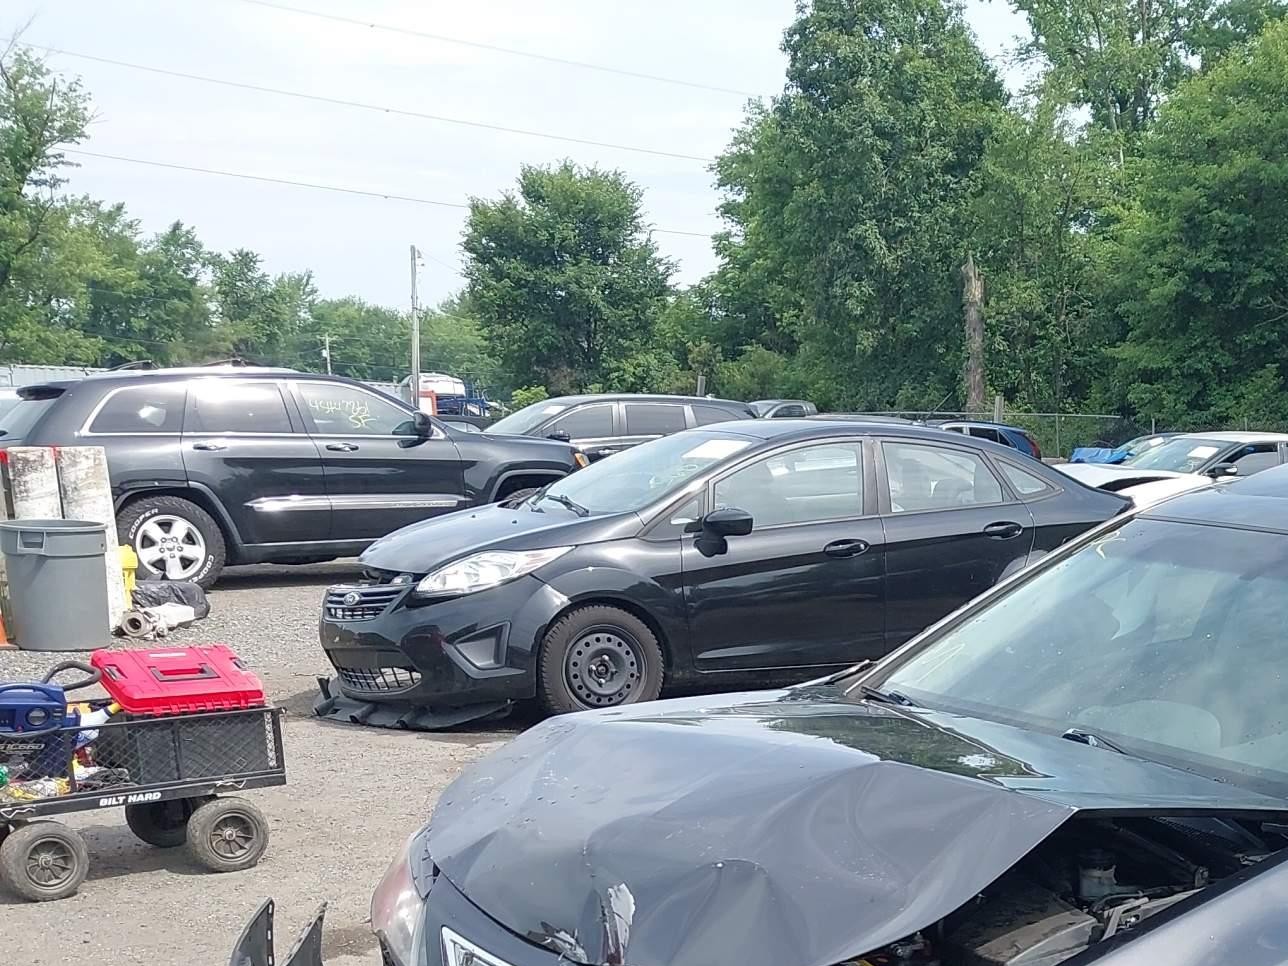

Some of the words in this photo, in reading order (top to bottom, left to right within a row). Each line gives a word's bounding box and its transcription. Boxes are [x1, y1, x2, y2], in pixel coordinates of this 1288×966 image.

[129, 508, 159, 540] COOPER
[99, 796, 126, 807] BILT
[127, 792, 162, 803] HARD
